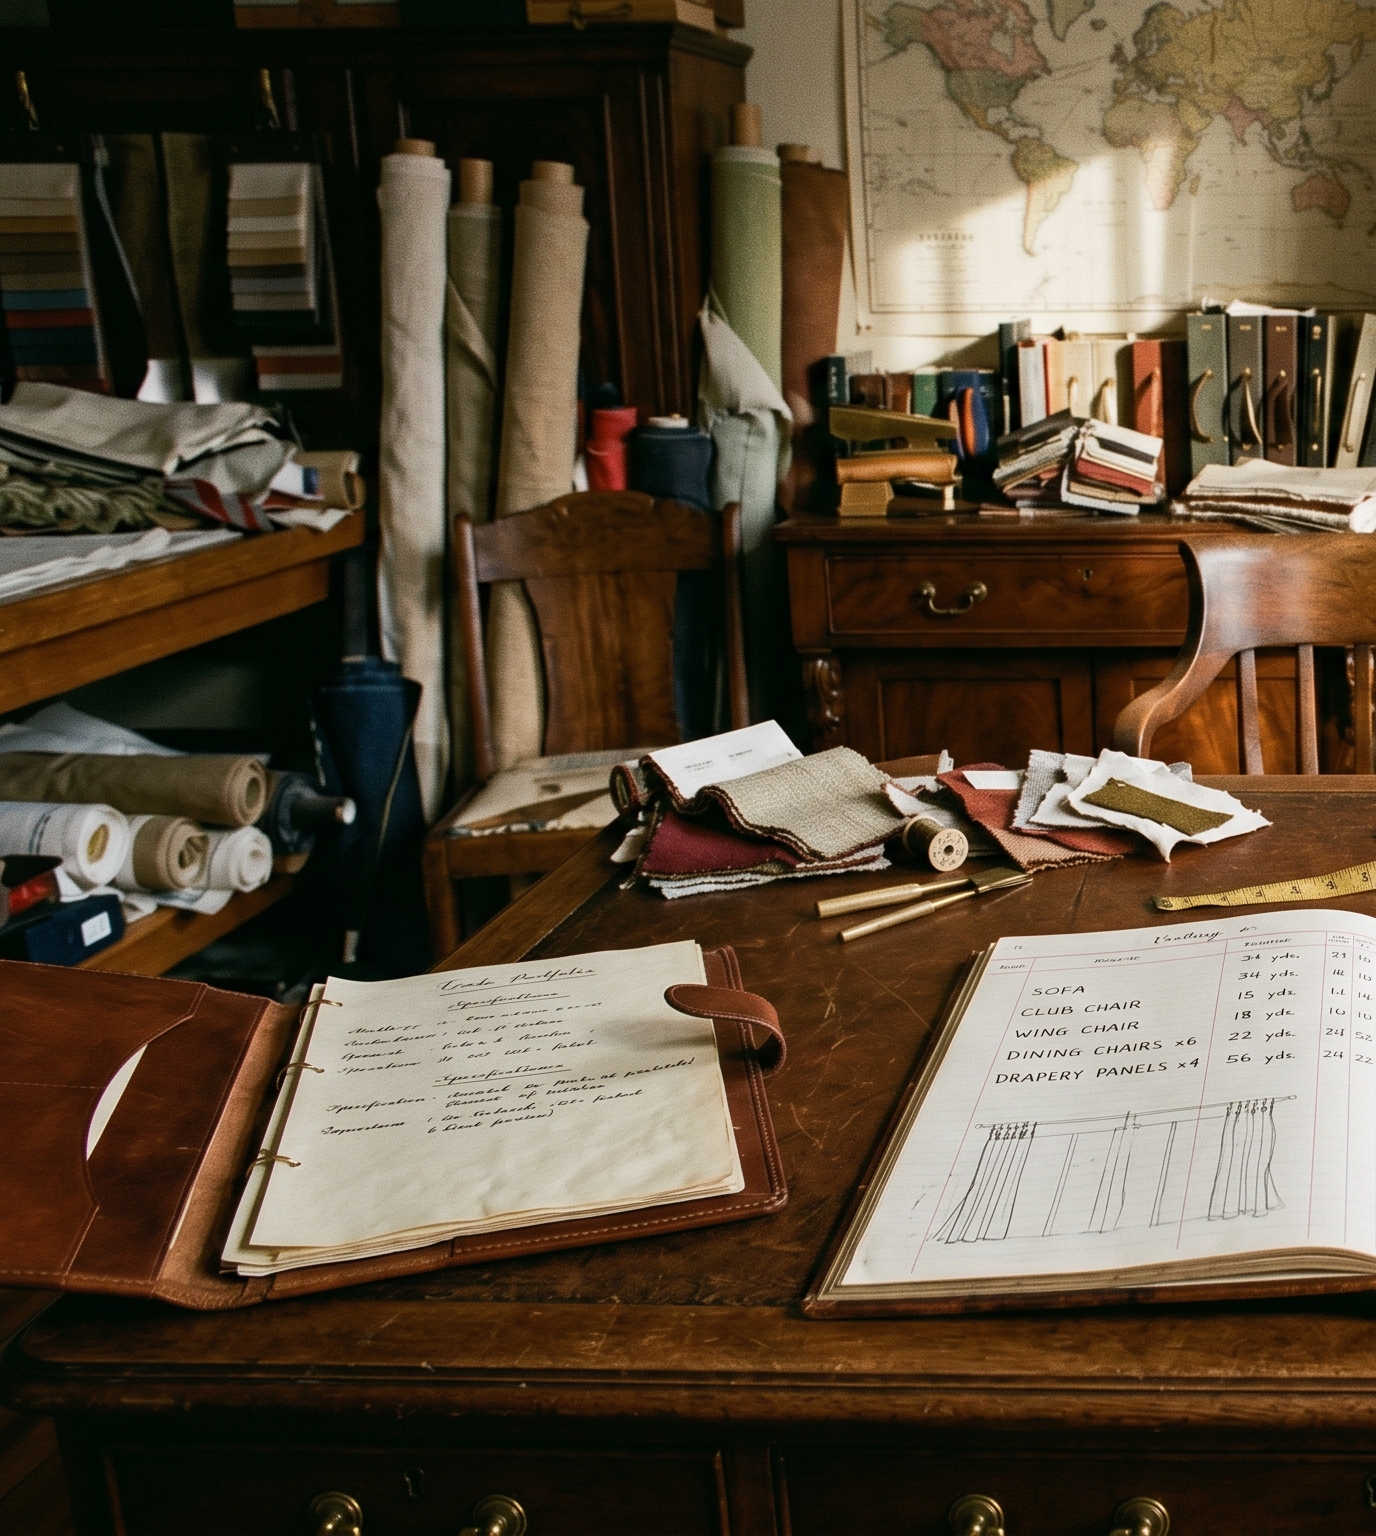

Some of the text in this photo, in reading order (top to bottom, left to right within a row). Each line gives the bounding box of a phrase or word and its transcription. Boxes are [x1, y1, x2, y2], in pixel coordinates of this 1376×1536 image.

[1238, 971, 1260, 980] 34
[1031, 985, 1085, 996] SOFA
[1238, 990, 1254, 1000] 15
[1020, 1000, 1141, 1017] CLUB CHAIR
[1234, 1010, 1252, 1021] 18
[1015, 1021, 1139, 1038] WING CHAIR
[1228, 1030, 1252, 1041] 22
[1006, 1036, 1197, 1061] DINING CHAIRS x6
[1225, 1050, 1296, 1065] 56 yds.
[995, 1057, 1199, 1084] DRAPERY PANELS x4
